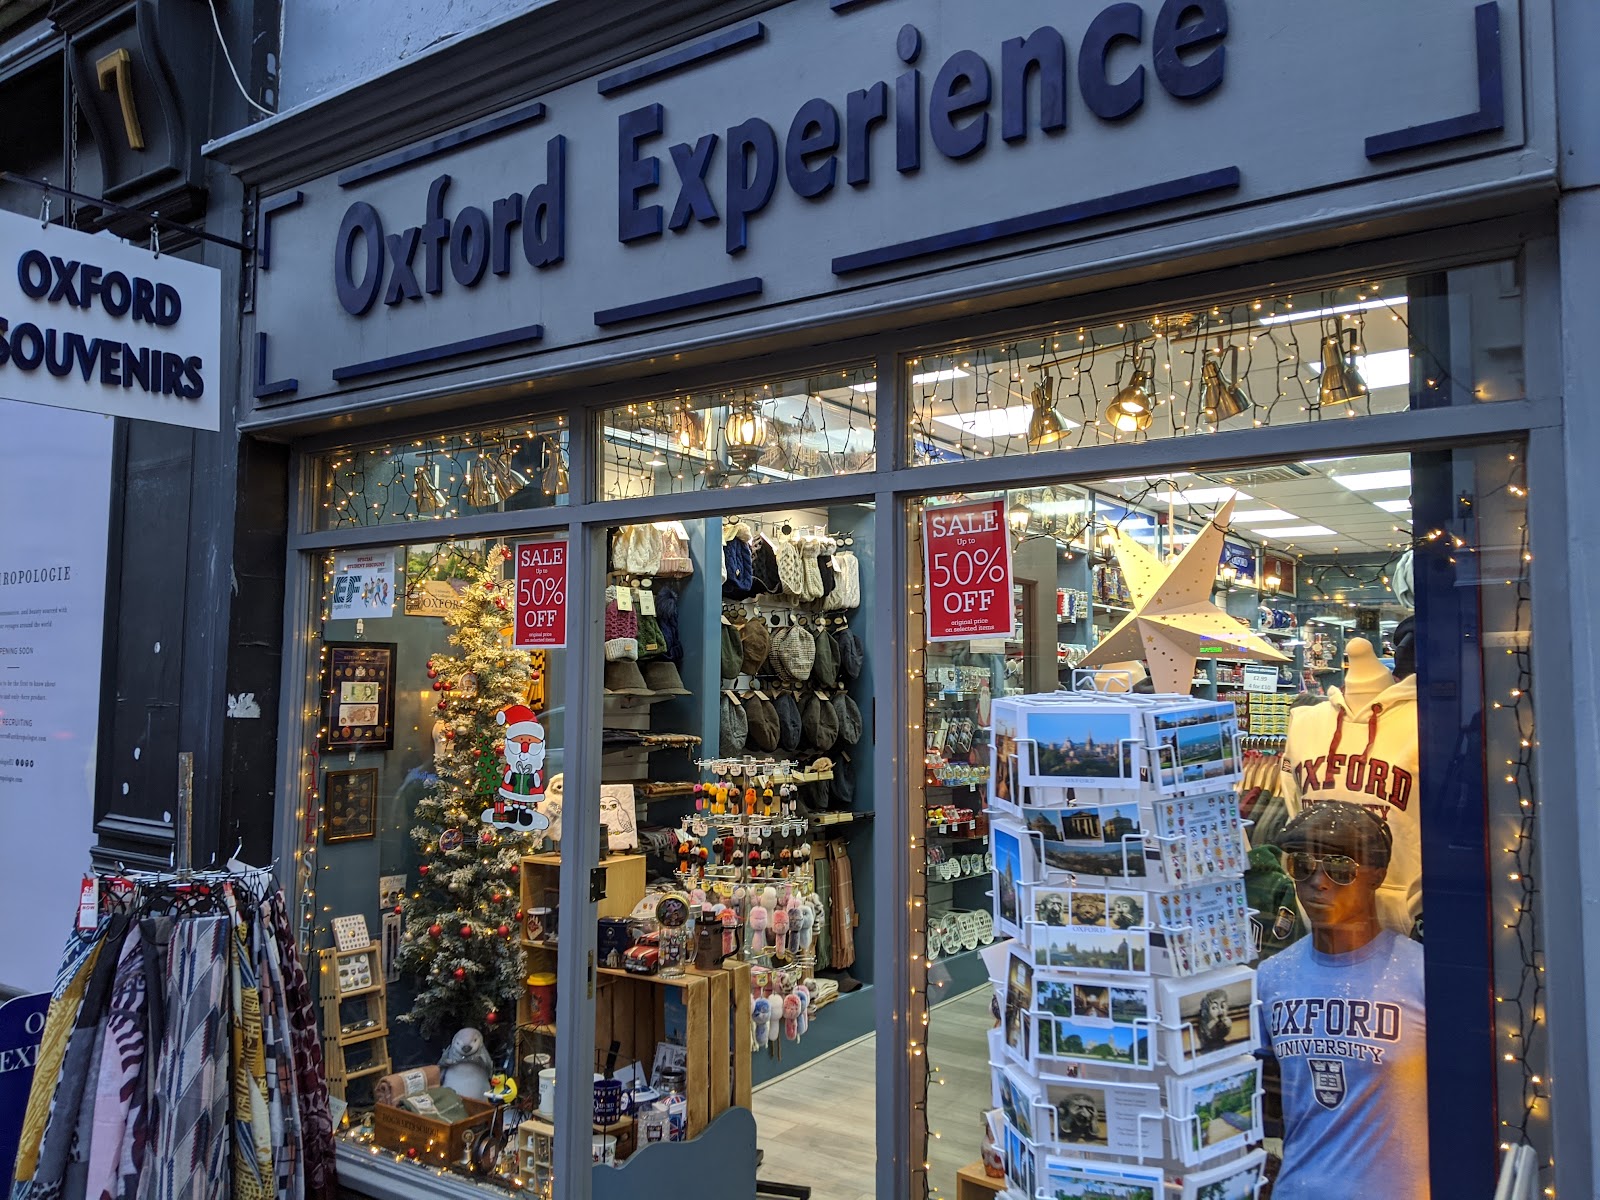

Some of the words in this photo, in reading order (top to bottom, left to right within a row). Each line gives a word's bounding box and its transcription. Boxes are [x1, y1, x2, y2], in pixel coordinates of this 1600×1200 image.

[96, 48, 144, 150] 7
[335, 134, 566, 315] Oxford
[618, 0, 1228, 255] Experience
[18, 249, 182, 326] OXFORD
[932, 509, 999, 538] SALE
[956, 538, 967, 546] Up
[521, 548, 563, 567] SALE
[933, 546, 1005, 587] 50%
[0, 566, 71, 586] ROPOLOGIE
[333, 576, 362, 603] EF
[423, 597, 460, 609] OXFOR
[519, 577, 564, 606] 50%
[943, 589, 995, 614] OFF
[525, 610, 557, 628] OFF
[973, 618, 989, 626] price
[304, 741, 319, 845] SALE
[299, 852, 313, 956] SALE
[1271, 998, 1402, 1043] OXFORD
[1275, 1037, 1385, 1065] UNIVERSITY
